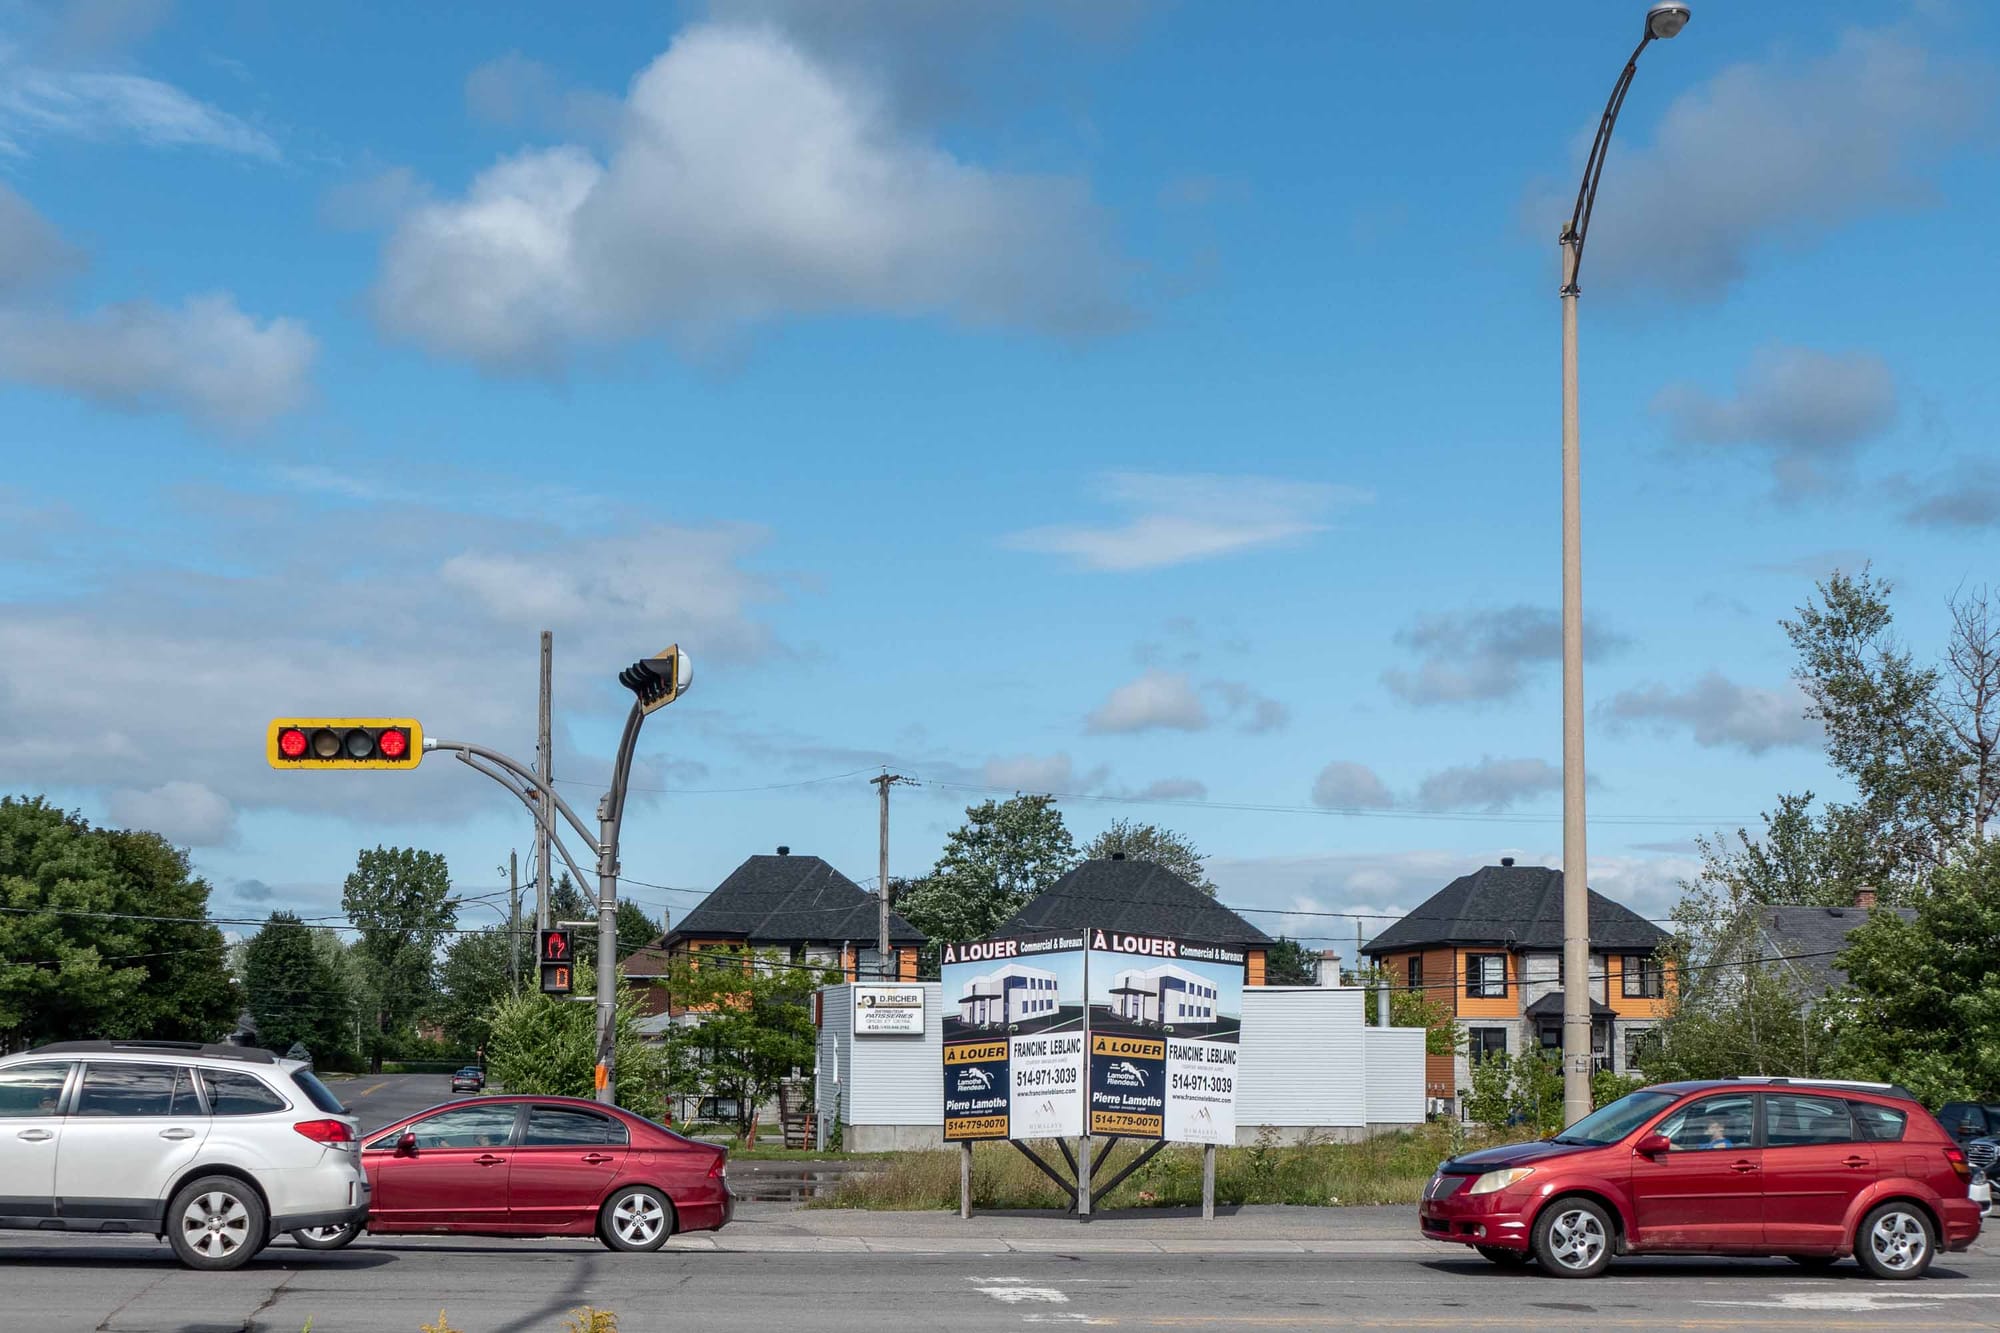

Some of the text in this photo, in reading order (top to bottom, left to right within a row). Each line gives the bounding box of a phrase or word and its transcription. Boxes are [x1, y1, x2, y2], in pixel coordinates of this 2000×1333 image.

[944, 937, 1083, 963] À LOUER Commercial & Bureaux
[1093, 930, 1243, 962] À LOUER Commercial & Bureaux
[947, 1047, 1005, 1061] À LOUER
[1014, 1038, 1081, 1057] FRANCINE LEBLANC
[1096, 1038, 1162, 1056] À LOUER
[1169, 1045, 1237, 1065] FRANCINE LEBLANC
[1017, 1067, 1077, 1087] 514-971-3039
[1172, 1074, 1232, 1093] 514-971-3039
[946, 1097, 1007, 1110] Pierre Lamothe
[1093, 1092, 1162, 1107] Pierre Lamothe
[948, 1119, 1005, 1130] 514-779-0070
[1095, 1115, 1159, 1127] 514-779-0070
